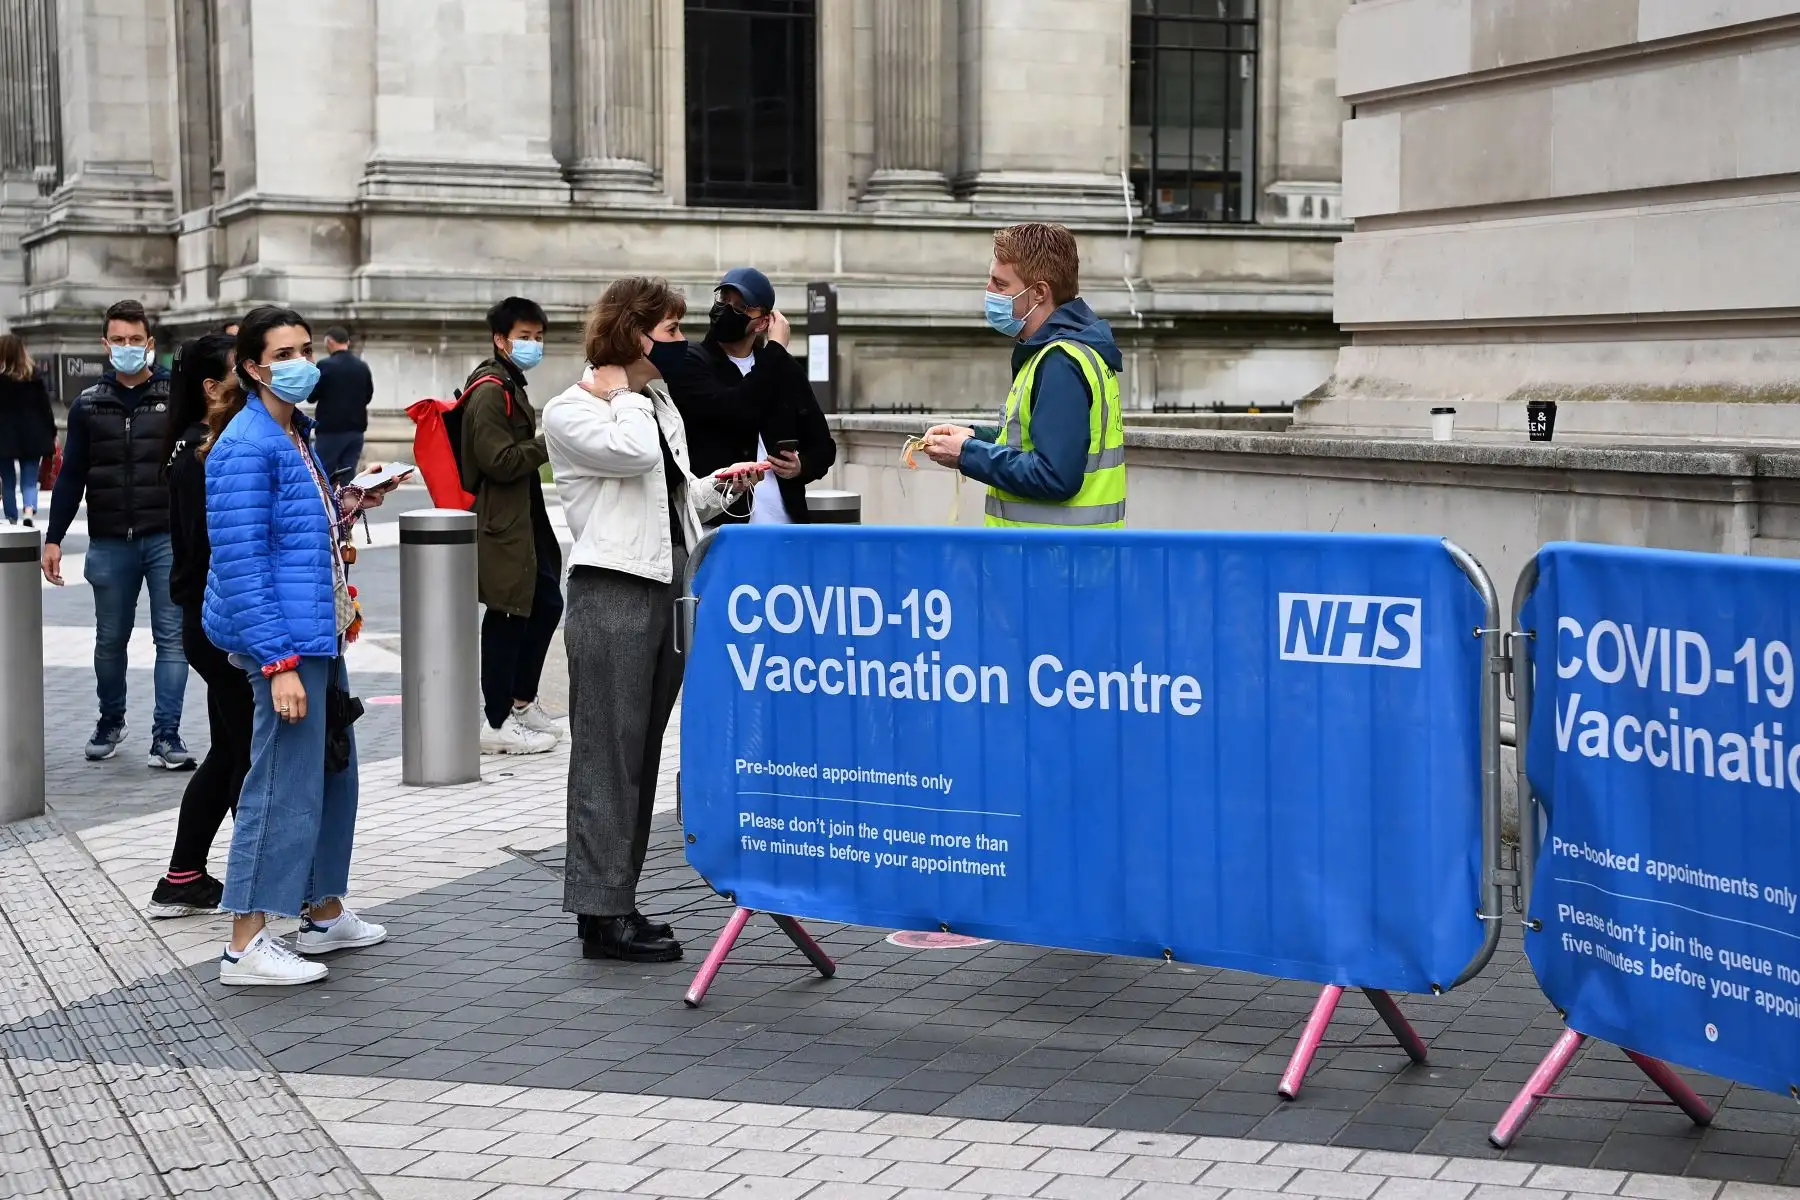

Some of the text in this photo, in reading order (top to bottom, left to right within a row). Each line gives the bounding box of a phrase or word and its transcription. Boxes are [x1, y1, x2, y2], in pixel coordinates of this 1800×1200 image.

[727, 584, 952, 641] COVID-19
[1283, 599, 1416, 661] NHS
[726, 643, 1202, 716] Vaccination Centre
[1557, 616, 1795, 709] COVID-19
[735, 758, 953, 795] Pre-booked appointments only
[739, 812, 785, 832] Please
[828, 820, 855, 839] join
[858, 823, 879, 840] the
[883, 828, 926, 849] queue
[930, 834, 972, 849] more
[975, 834, 1009, 852] than
[740, 835, 1007, 877] five minutes before your appointment
[1552, 836, 1798, 914] Pre-booked appointments only
[1558, 903, 1605, 933] Please
[1649, 927, 1686, 953] join
[1688, 937, 1714, 962] the
[1718, 949, 1773, 976] queue
[1777, 964, 1800, 986] mo
[1561, 932, 1593, 955] five
[1595, 944, 1645, 977] minutes
[1650, 957, 1707, 990] before
[1710, 977, 1750, 1001] your
